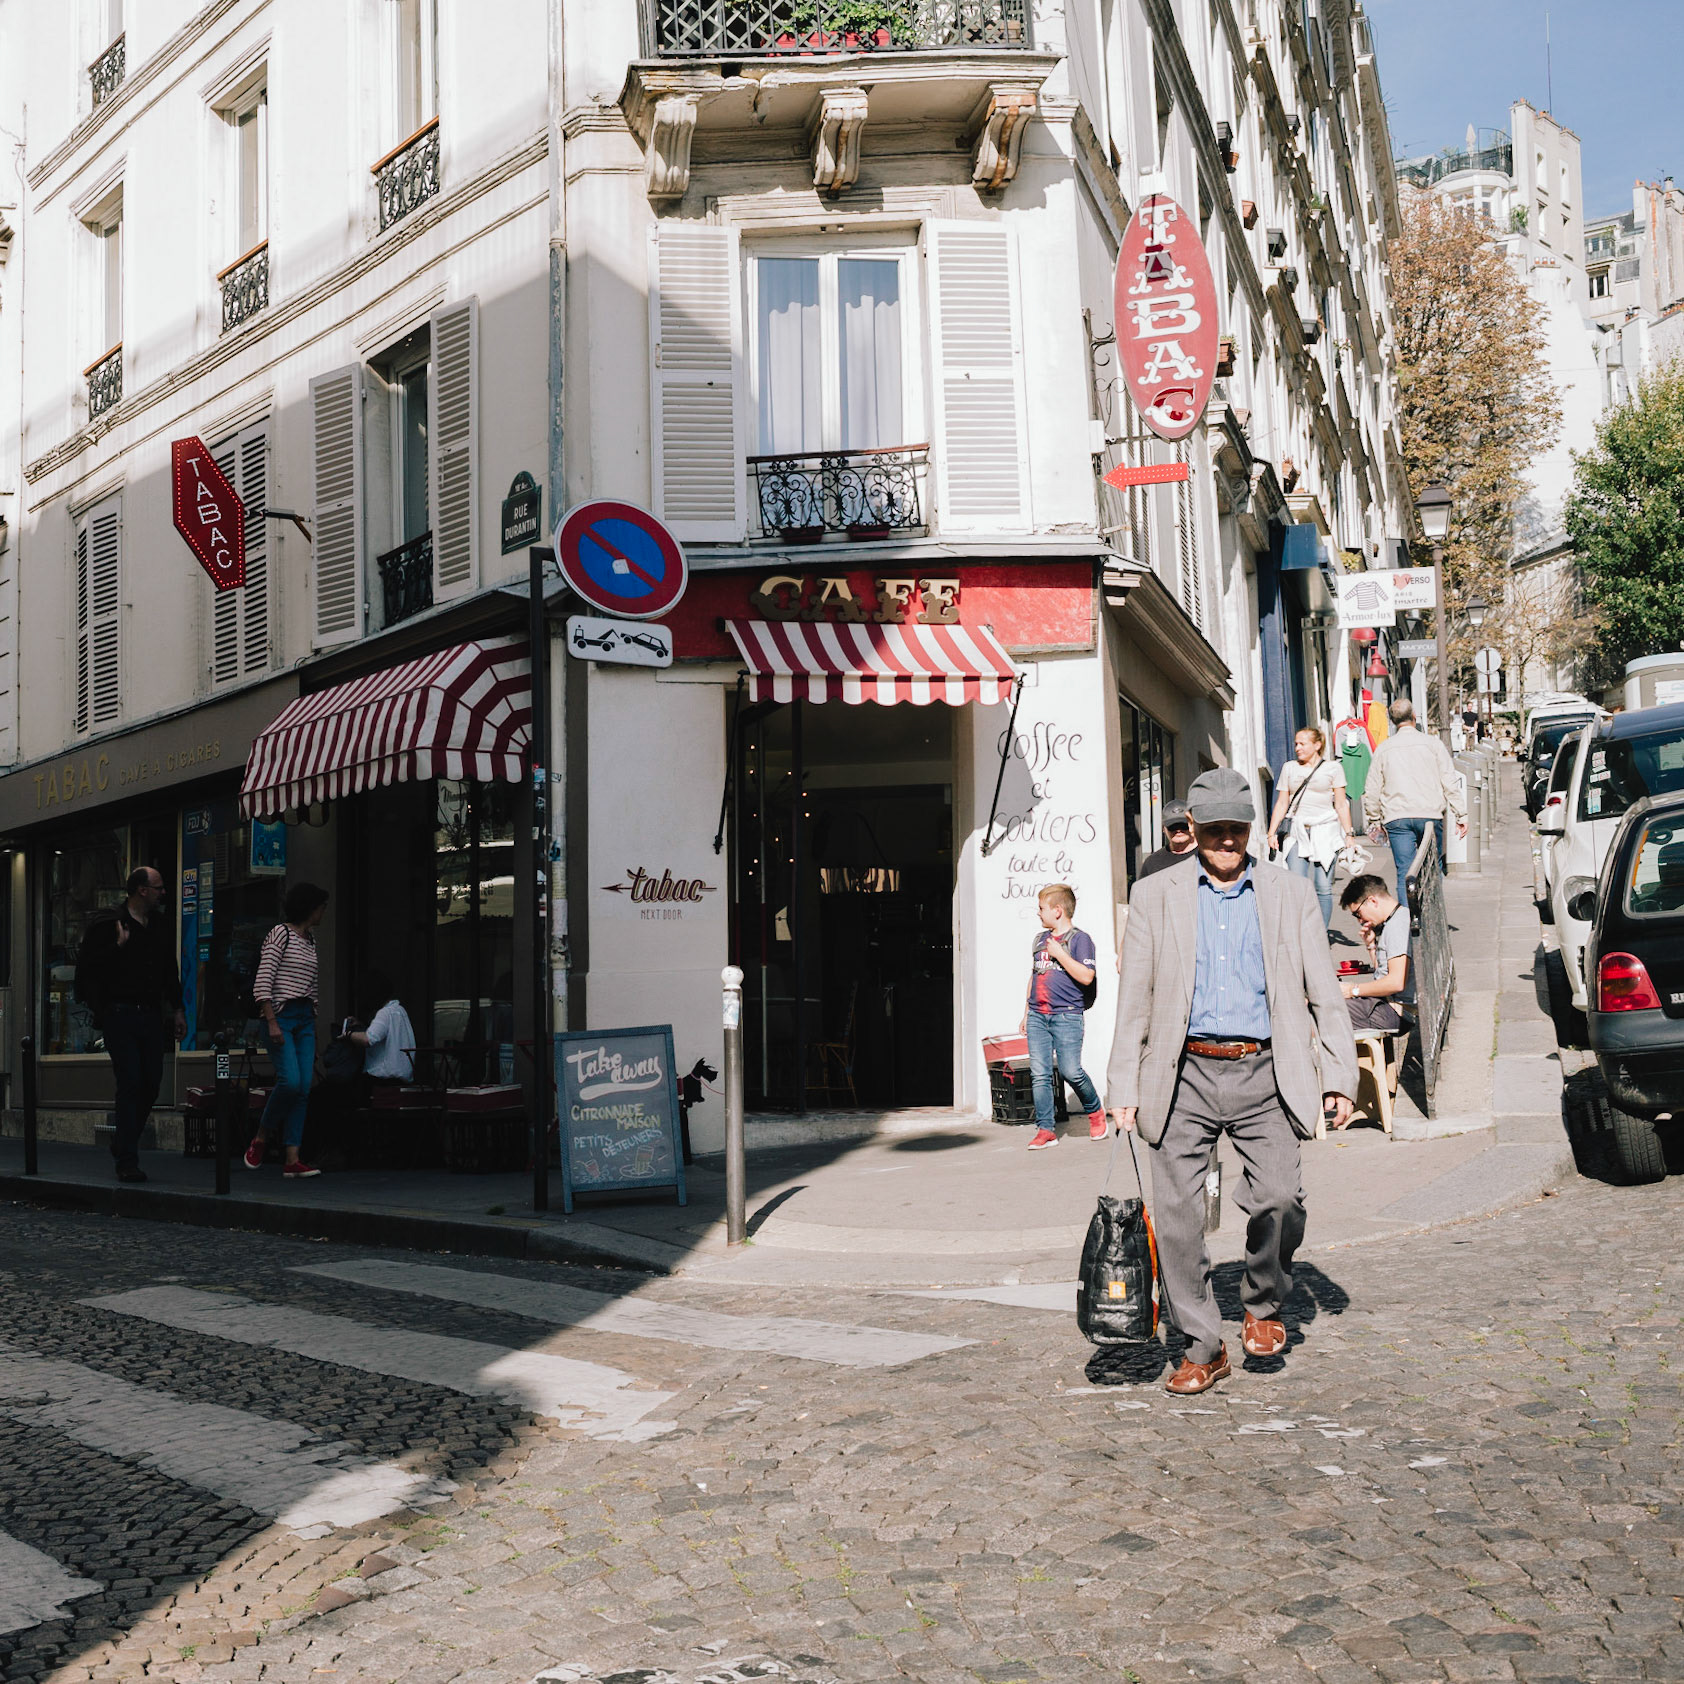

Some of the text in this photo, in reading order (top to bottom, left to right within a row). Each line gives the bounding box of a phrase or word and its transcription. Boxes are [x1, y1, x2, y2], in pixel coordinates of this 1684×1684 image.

[1127, 202, 1204, 429] TABAC
[186, 457, 233, 569] TABAC
[513, 503, 528, 520] RUE
[504, 517, 537, 541] DURANTIN
[1404, 576, 1431, 585] VERSO
[751, 576, 961, 624] CAFE
[33, 752, 110, 810] TABAC
[119, 763, 148, 786] CAVE
[167, 740, 221, 773] CIGARES
[1031, 777, 1053, 799] et
[1008, 850, 1075, 874] toute la
[626, 866, 706, 903] tabac
[640, 909, 683, 920] NEXT DOOR
[218, 1056, 228, 1077] BNE
